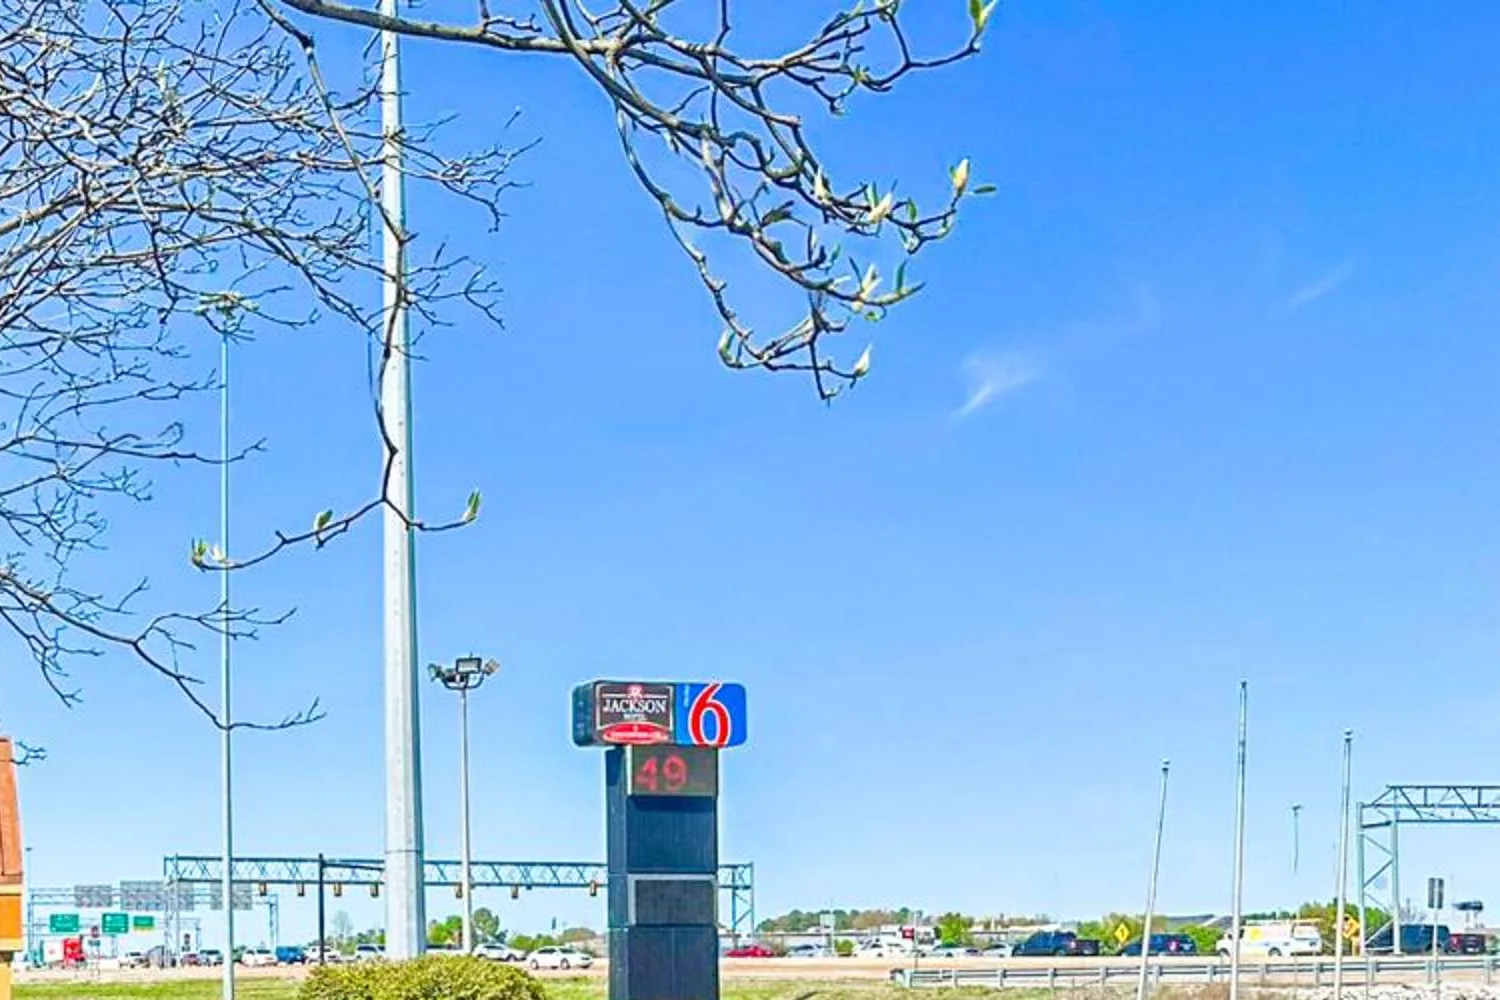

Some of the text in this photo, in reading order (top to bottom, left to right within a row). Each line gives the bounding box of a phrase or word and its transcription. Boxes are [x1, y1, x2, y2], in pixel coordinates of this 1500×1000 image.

[602, 699, 667, 713] JACKSON
[688, 682, 732, 748] 6
[635, 755, 688, 791] 49
